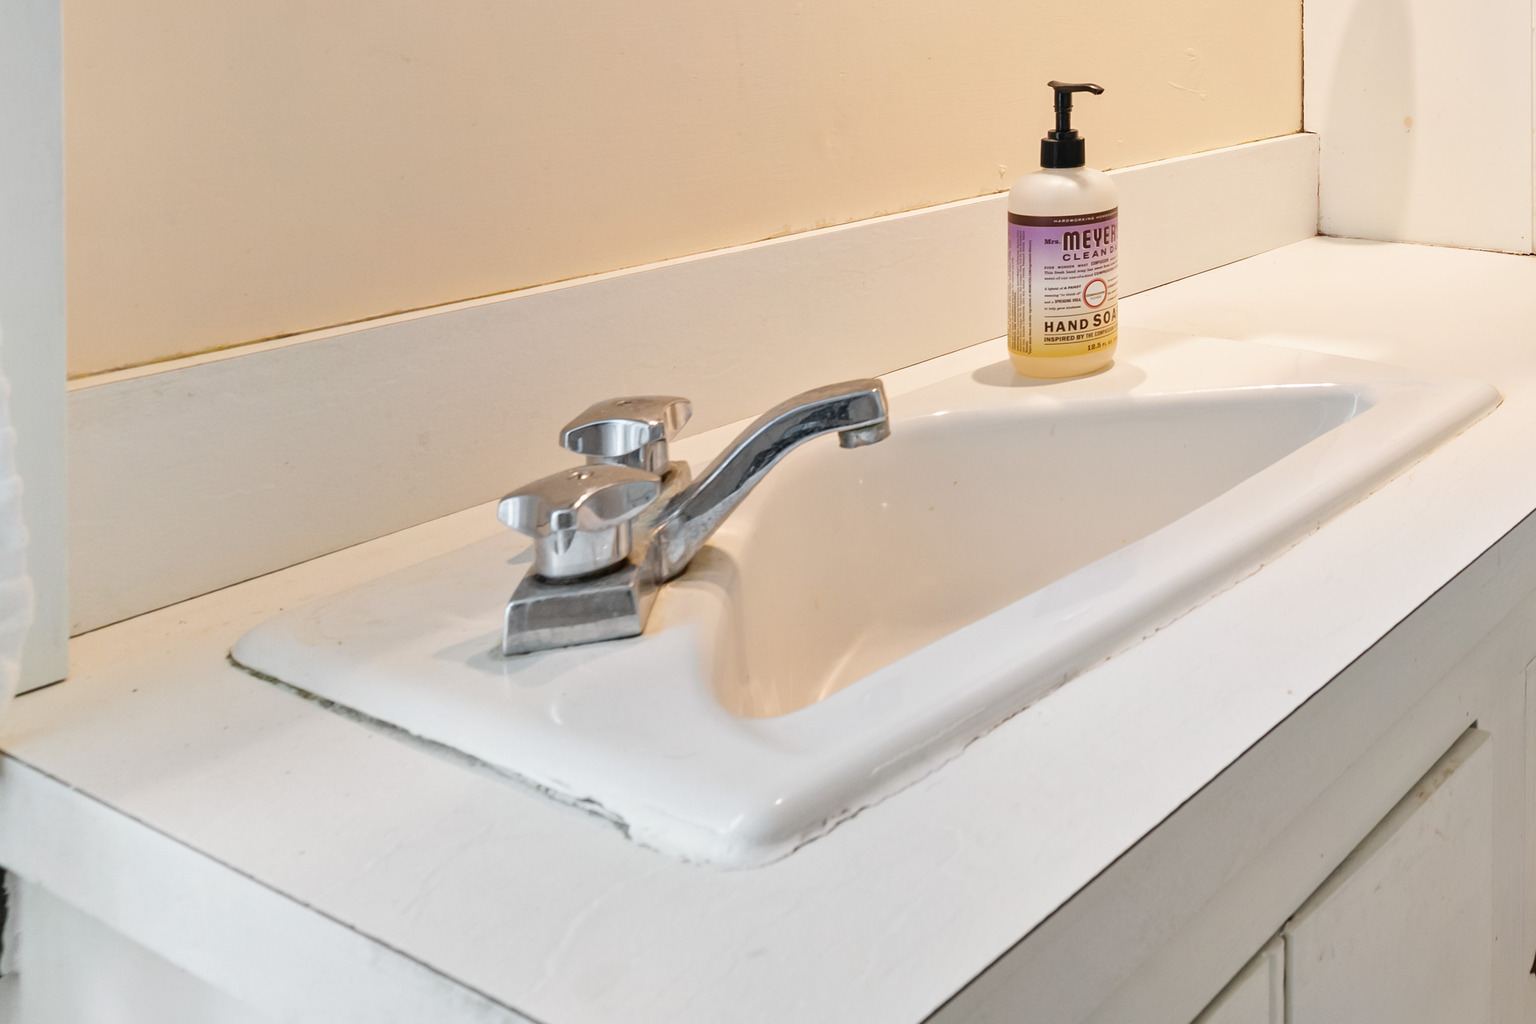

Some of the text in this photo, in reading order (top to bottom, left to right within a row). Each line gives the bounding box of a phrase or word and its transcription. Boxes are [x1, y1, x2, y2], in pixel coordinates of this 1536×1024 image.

[1062, 248, 1107, 262] CLEAN
[1044, 318, 1089, 333] HAND
[1044, 335, 1076, 343] INSPIRED
